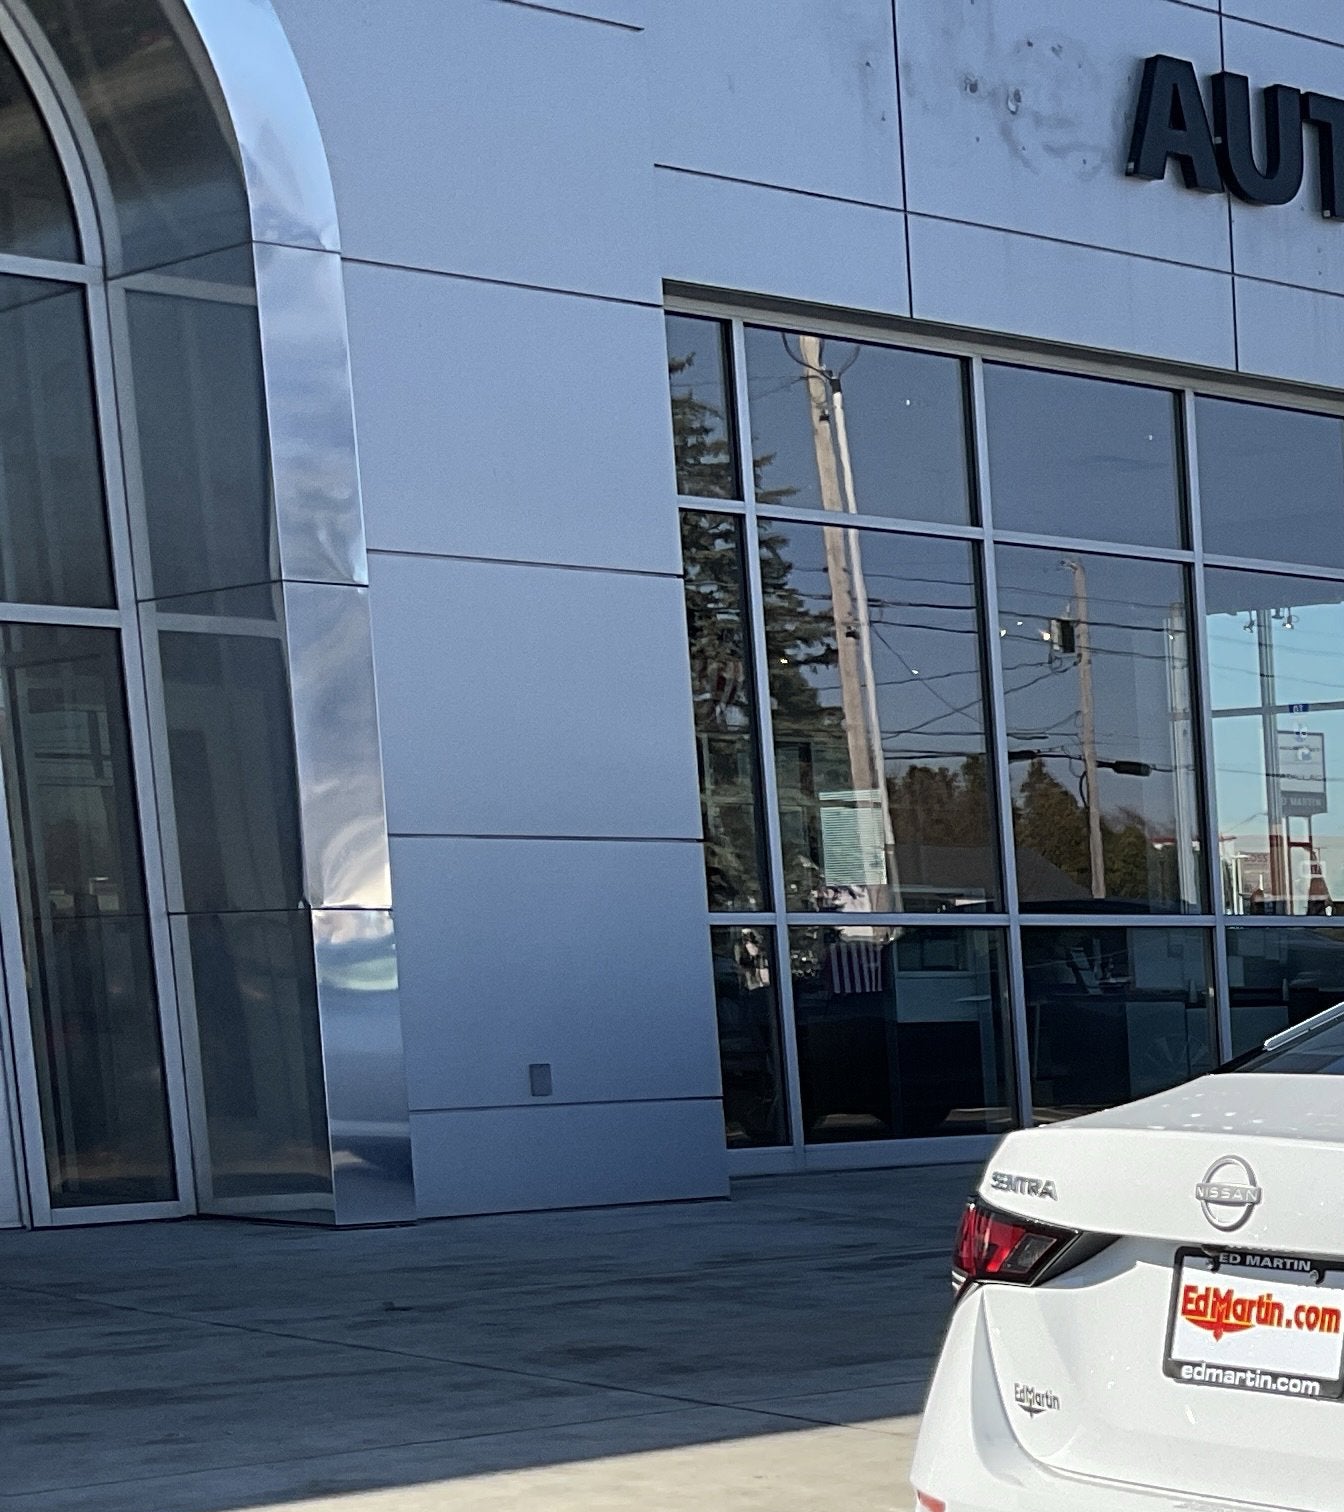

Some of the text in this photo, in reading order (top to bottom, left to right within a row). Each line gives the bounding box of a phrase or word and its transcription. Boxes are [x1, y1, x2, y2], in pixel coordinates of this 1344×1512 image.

[991, 1171, 1058, 1201] SENTRA
[1197, 1186, 1258, 1202] NISSAN
[1219, 1253, 1311, 1271] ED MARTIN
[1181, 1360, 1321, 1396] edmartin.com
